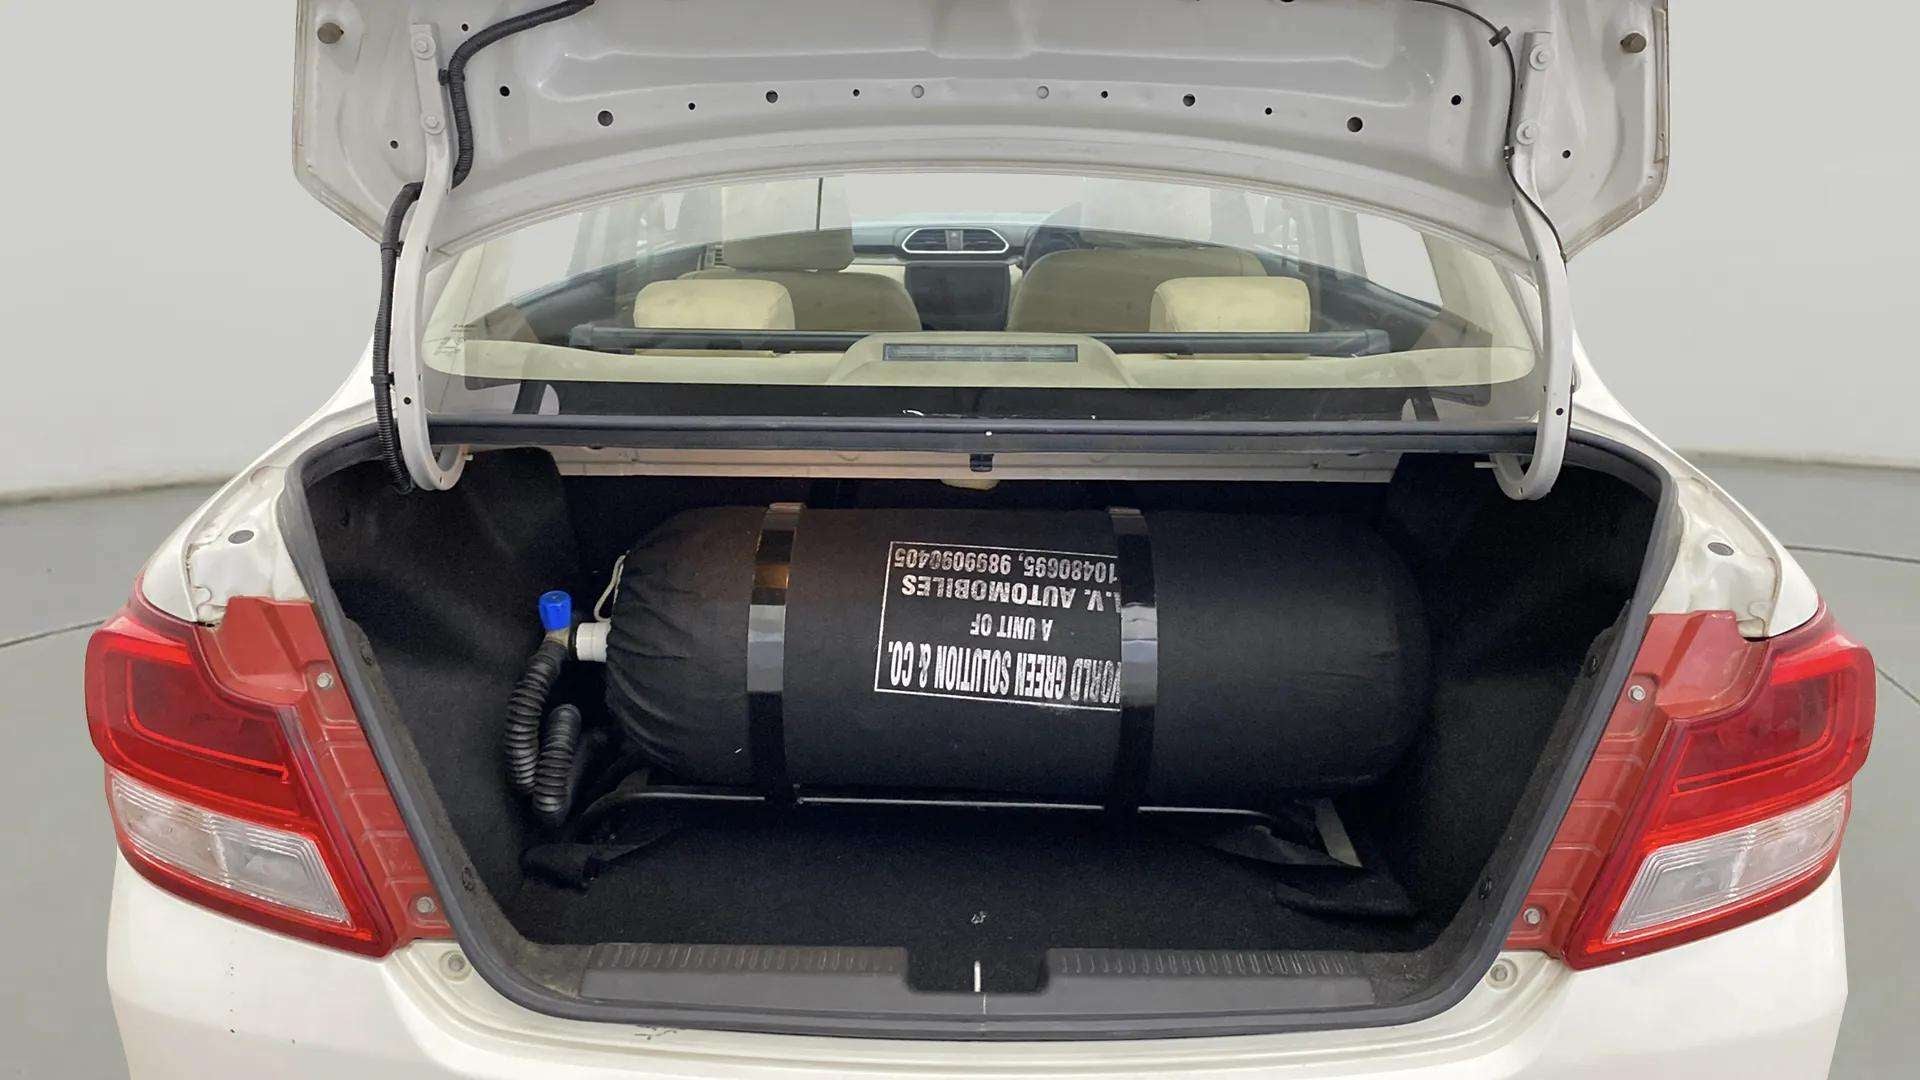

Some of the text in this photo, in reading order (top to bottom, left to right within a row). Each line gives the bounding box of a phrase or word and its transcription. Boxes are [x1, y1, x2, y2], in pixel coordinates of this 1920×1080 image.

[901, 574, 1077, 609] AUTOMOBILES
[969, 613, 1054, 641] A UNIT OF
[888, 641, 915, 687] CO.
[919, 643, 932, 689] &
[934, 645, 1012, 695] SOLUTION
[1014, 652, 1067, 700] GREEN
